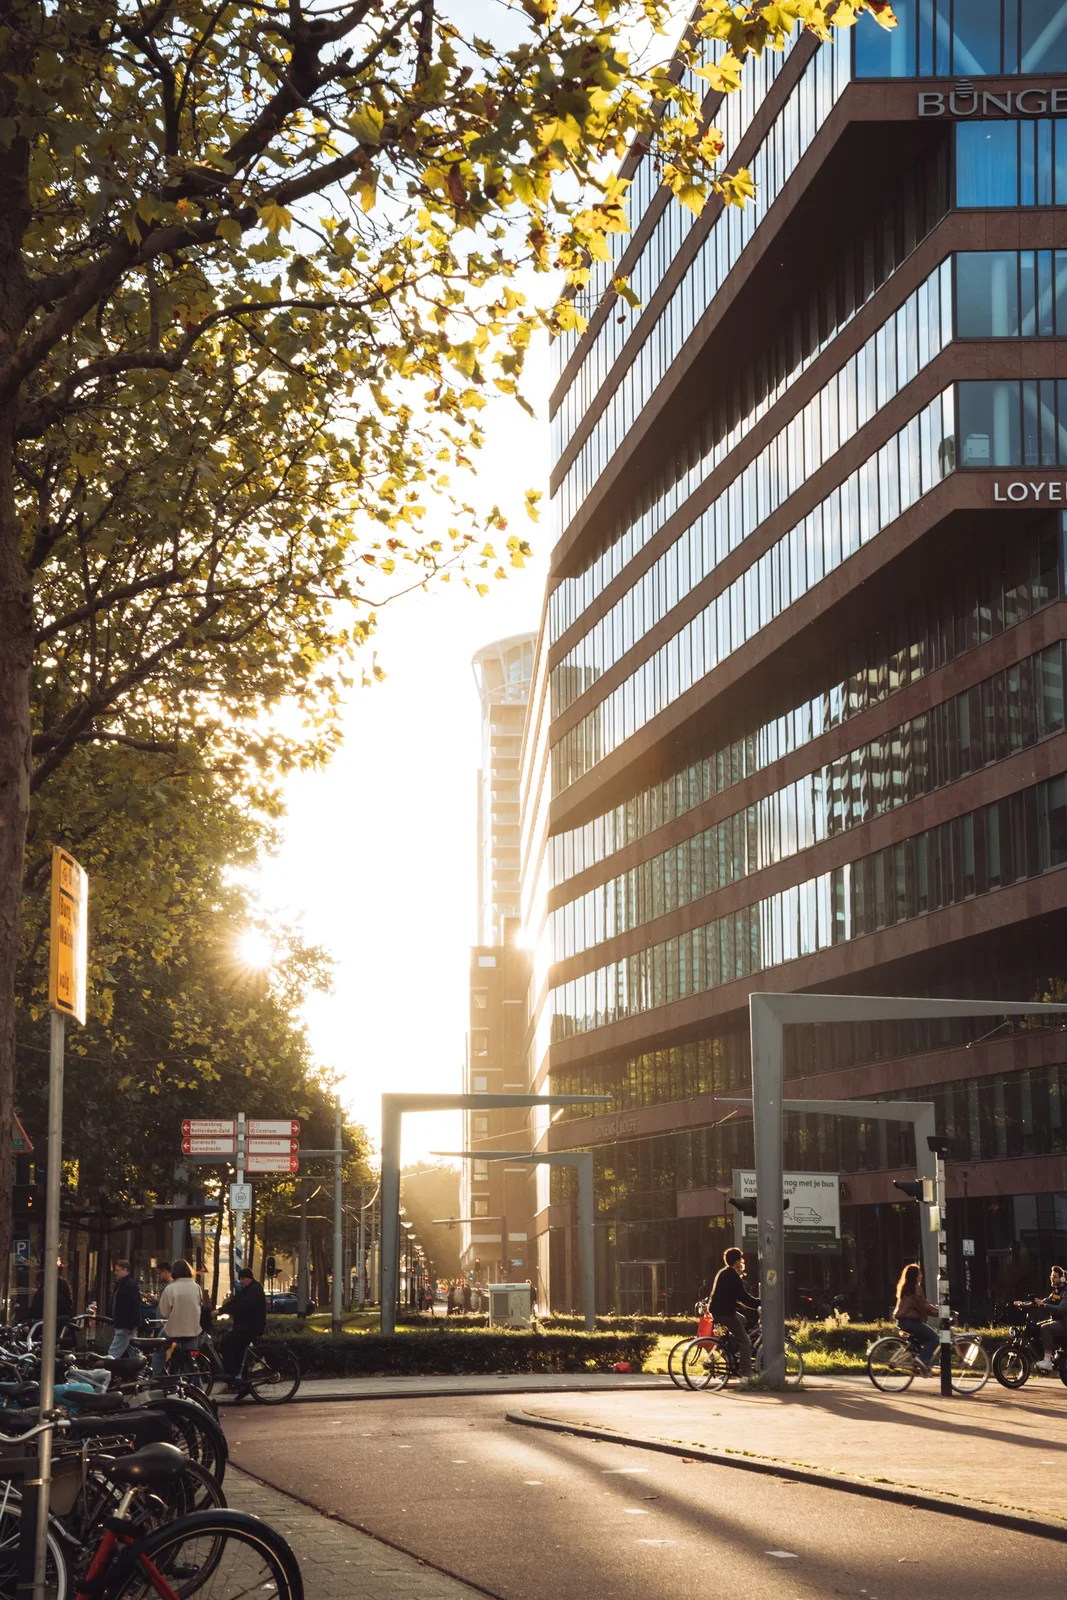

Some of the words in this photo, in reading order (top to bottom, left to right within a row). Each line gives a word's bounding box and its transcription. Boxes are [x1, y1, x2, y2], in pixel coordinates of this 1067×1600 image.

[918, 88, 1067, 117] BUNGE
[994, 482, 1067, 501] LOYE
[784, 1180, 798, 1188] nog
[813, 1179, 821, 1188] je
[17, 1242, 27, 1255] P
